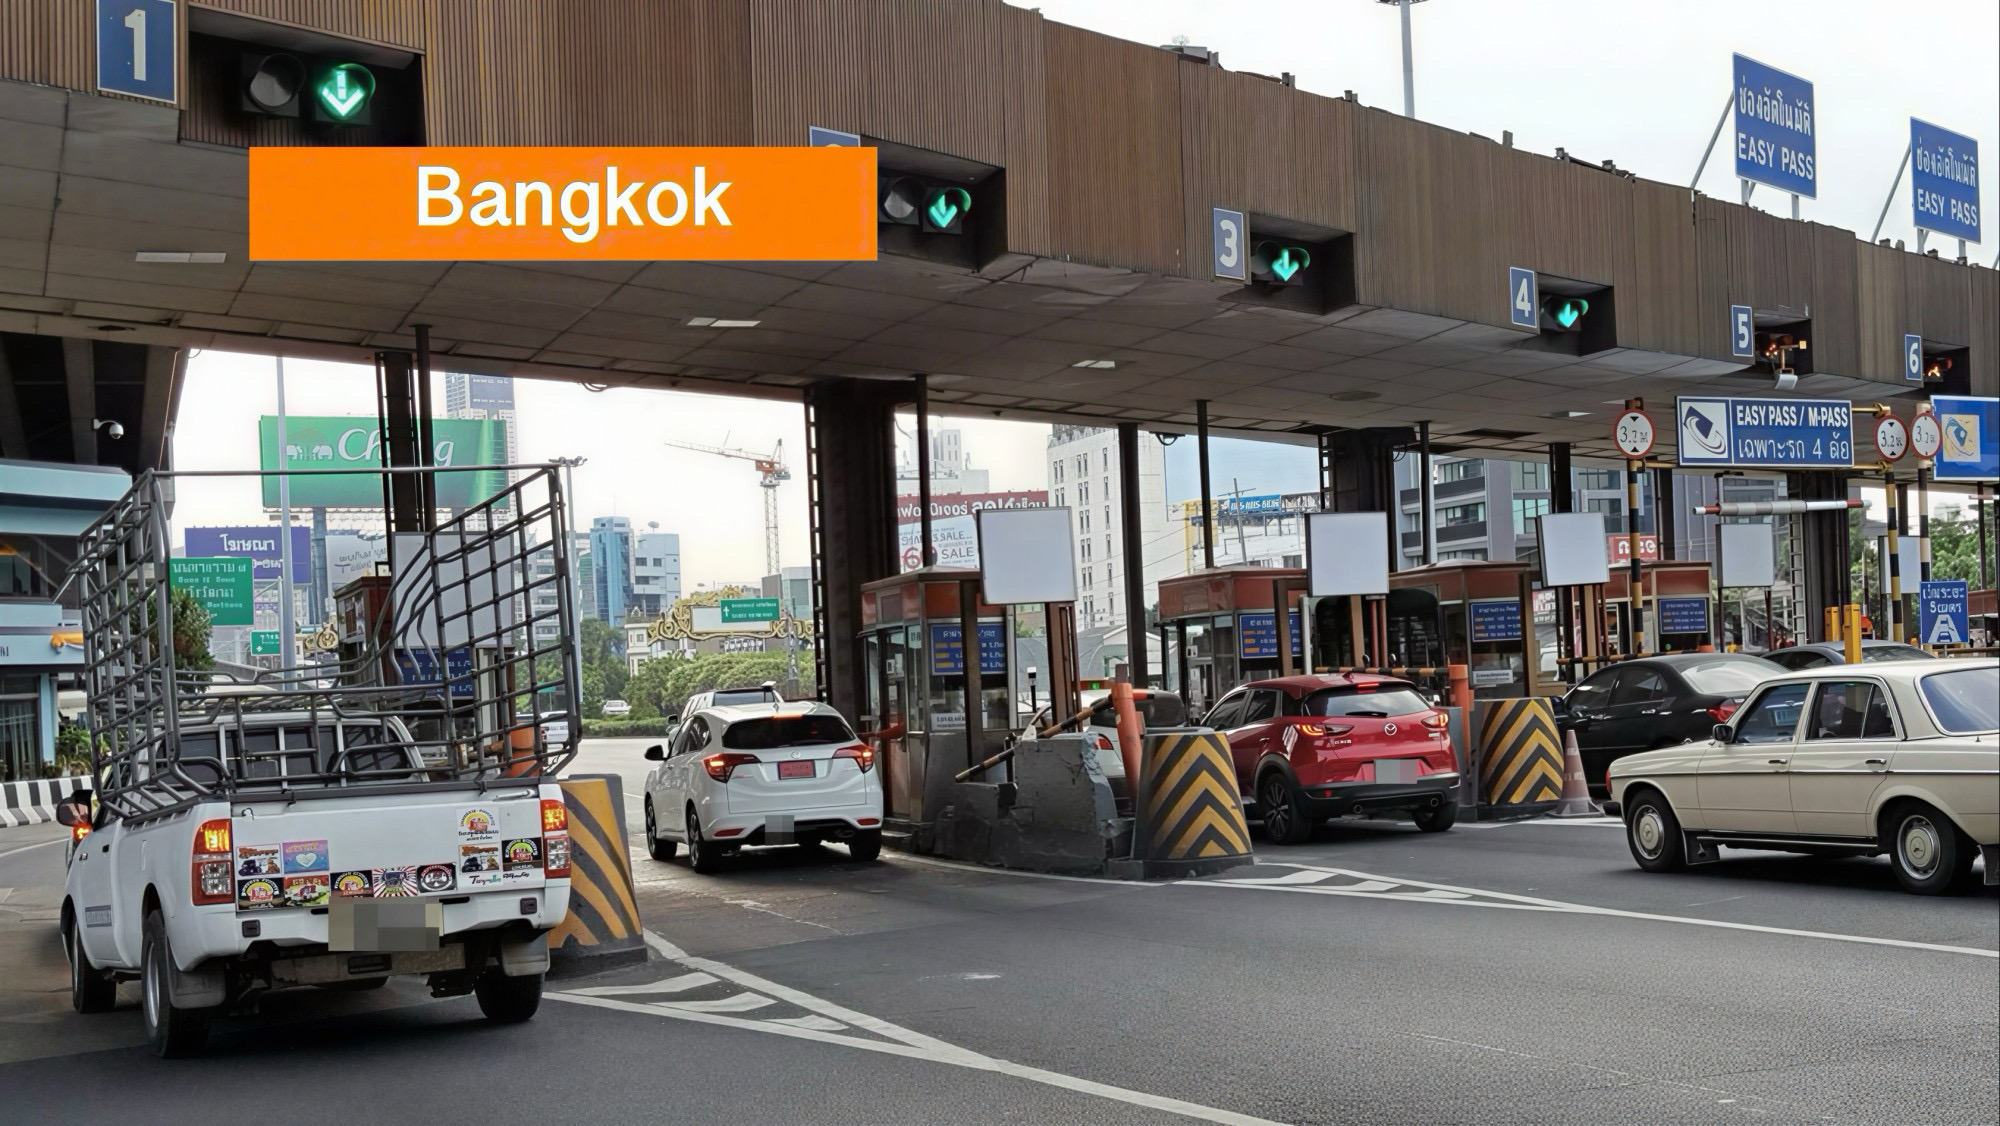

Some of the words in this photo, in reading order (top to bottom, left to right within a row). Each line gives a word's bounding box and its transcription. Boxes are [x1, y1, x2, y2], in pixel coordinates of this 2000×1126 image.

[124, 9, 147, 82] 1
[1738, 132, 1775, 168] EASY
[1781, 146, 1814, 180] PASS
[1917, 188, 1946, 217] EASY
[1950, 198, 1978, 227] PASS
[1219, 219, 1238, 268] 3
[1515, 277, 1532, 318] 4
[1737, 313, 1749, 349] 5
[1909, 342, 1919, 374] 6
[1736, 405, 1766, 426] EASY
[1768, 405, 1797, 427] PASS
[1799, 406, 1805, 426] /
[1808, 406, 1849, 428] M-PASS
[338, 428, 455, 467] Chg
[1812, 438, 1823, 460] 4
[941, 547, 975, 560] SALE
